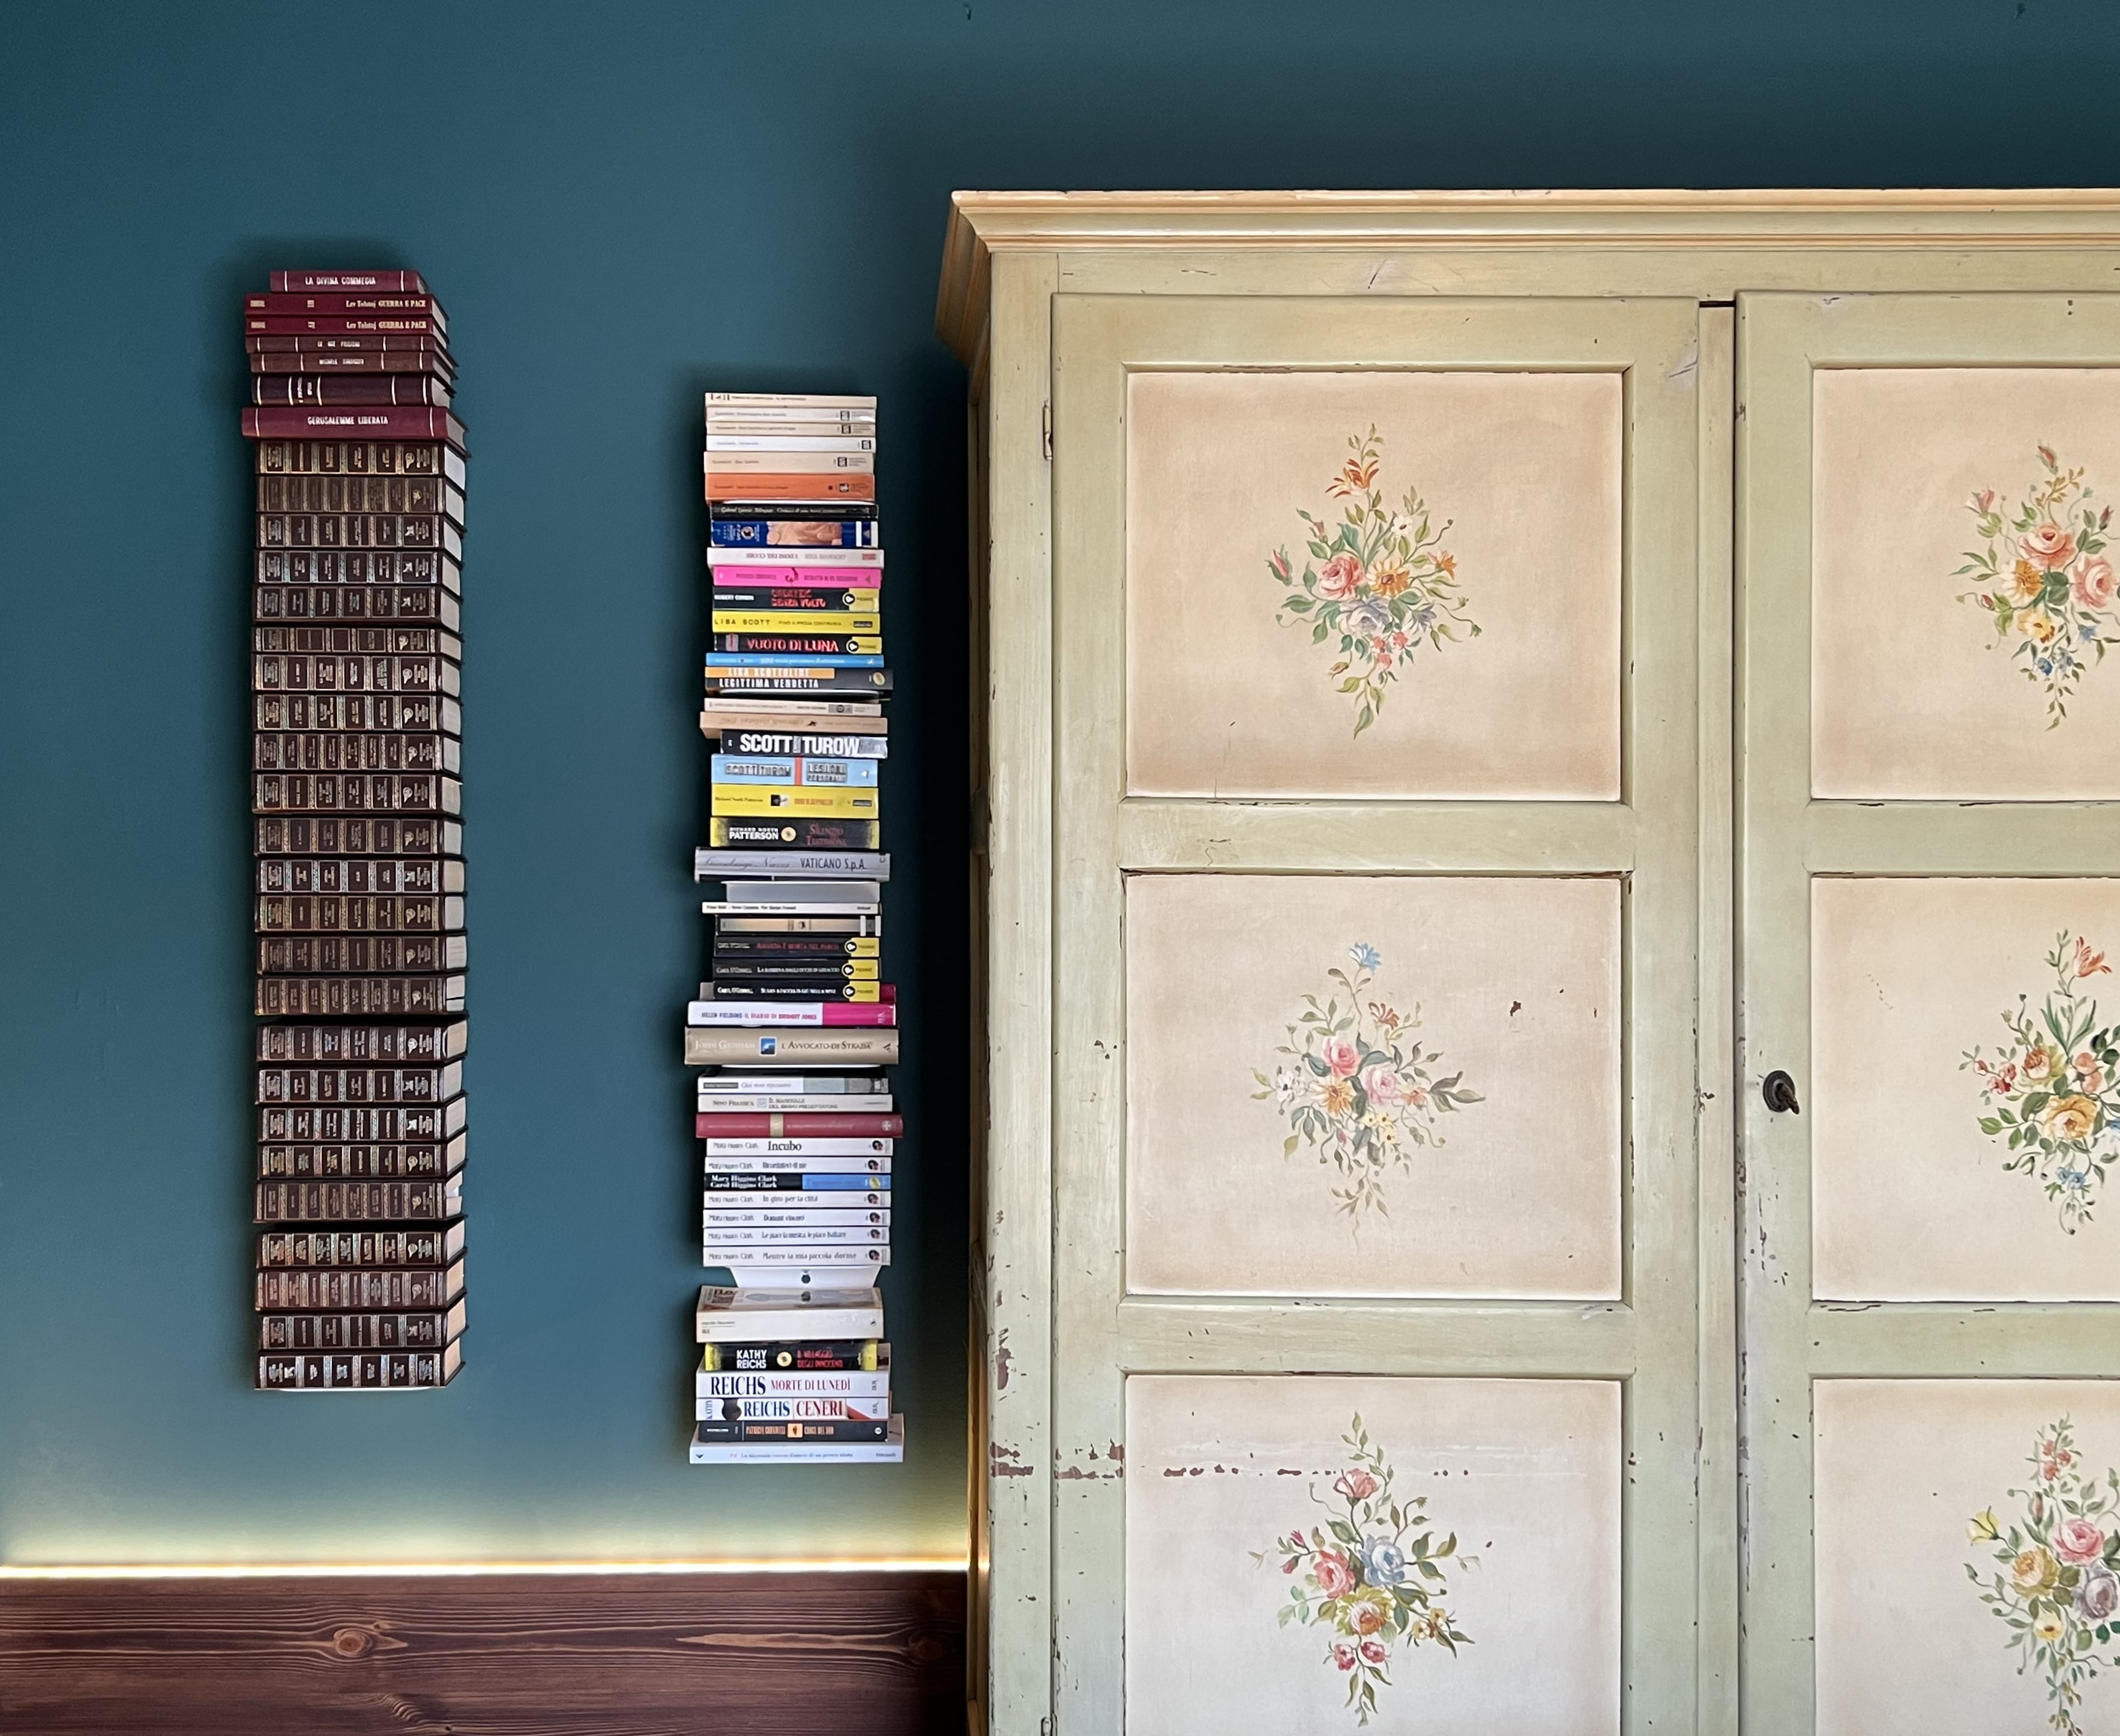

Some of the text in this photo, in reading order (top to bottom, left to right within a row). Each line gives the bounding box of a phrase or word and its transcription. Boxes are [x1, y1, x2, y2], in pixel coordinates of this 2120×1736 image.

[305, 276, 376, 285] LA DIVINA COMMEDIA
[307, 416, 388, 425] GERUSALEMME LIBERATA
[747, 638, 839, 652] VUOTO DI LUNA
[719, 678, 819, 688] LEGITTIMA VENDETTA
[739, 734, 860, 756] SCOTT TUROW
[729, 832, 779, 840] PATTERSON
[800, 858, 842, 869] VATICANO
[768, 1141, 802, 1151] Incubo
[736, 1349, 767, 1359] KATHY
[736, 1359, 767, 1369] REICHS
[711, 1376, 851, 1395] REICHS MORTE DI LUNEDÌ
[744, 1400, 843, 1417] REICHS CENERI
